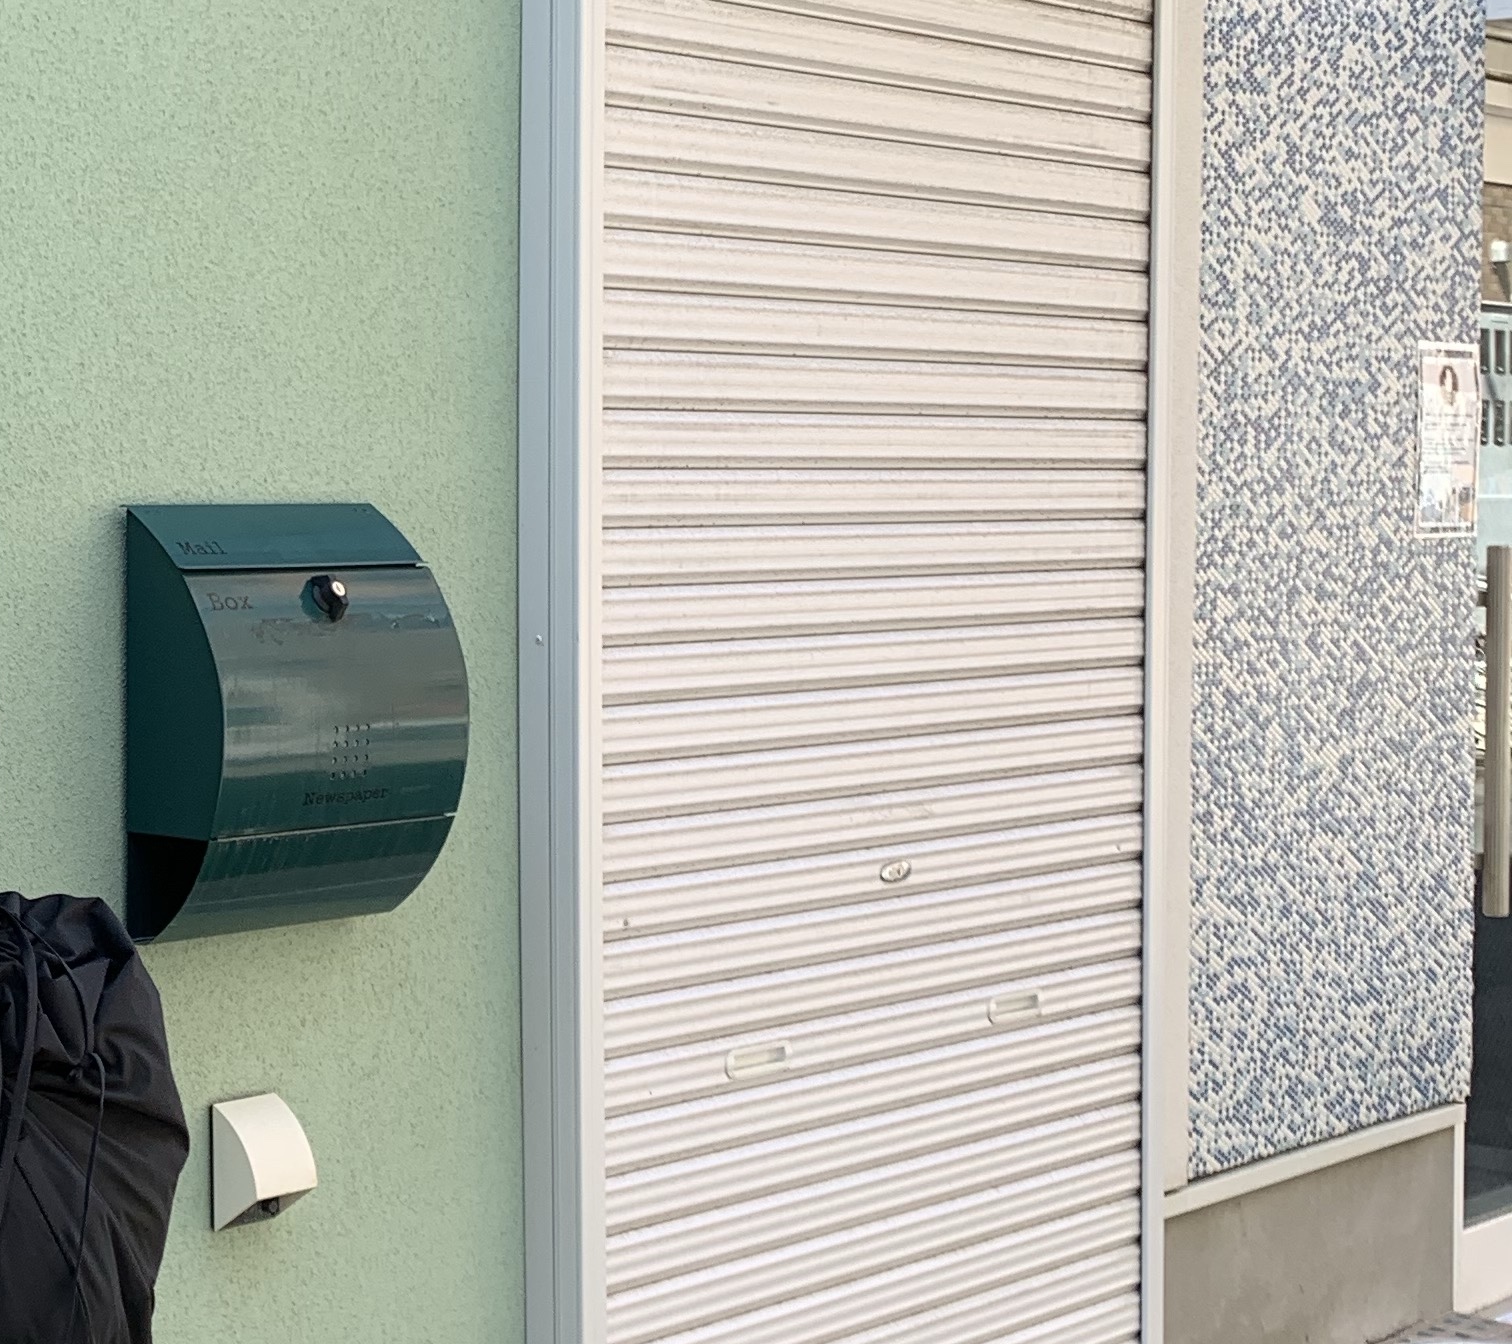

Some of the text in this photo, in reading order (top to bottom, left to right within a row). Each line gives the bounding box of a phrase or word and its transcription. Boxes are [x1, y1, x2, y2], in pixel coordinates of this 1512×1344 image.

[175, 540, 228, 555] Mail
[206, 591, 254, 611] Box
[302, 787, 388, 806] Newspaper
